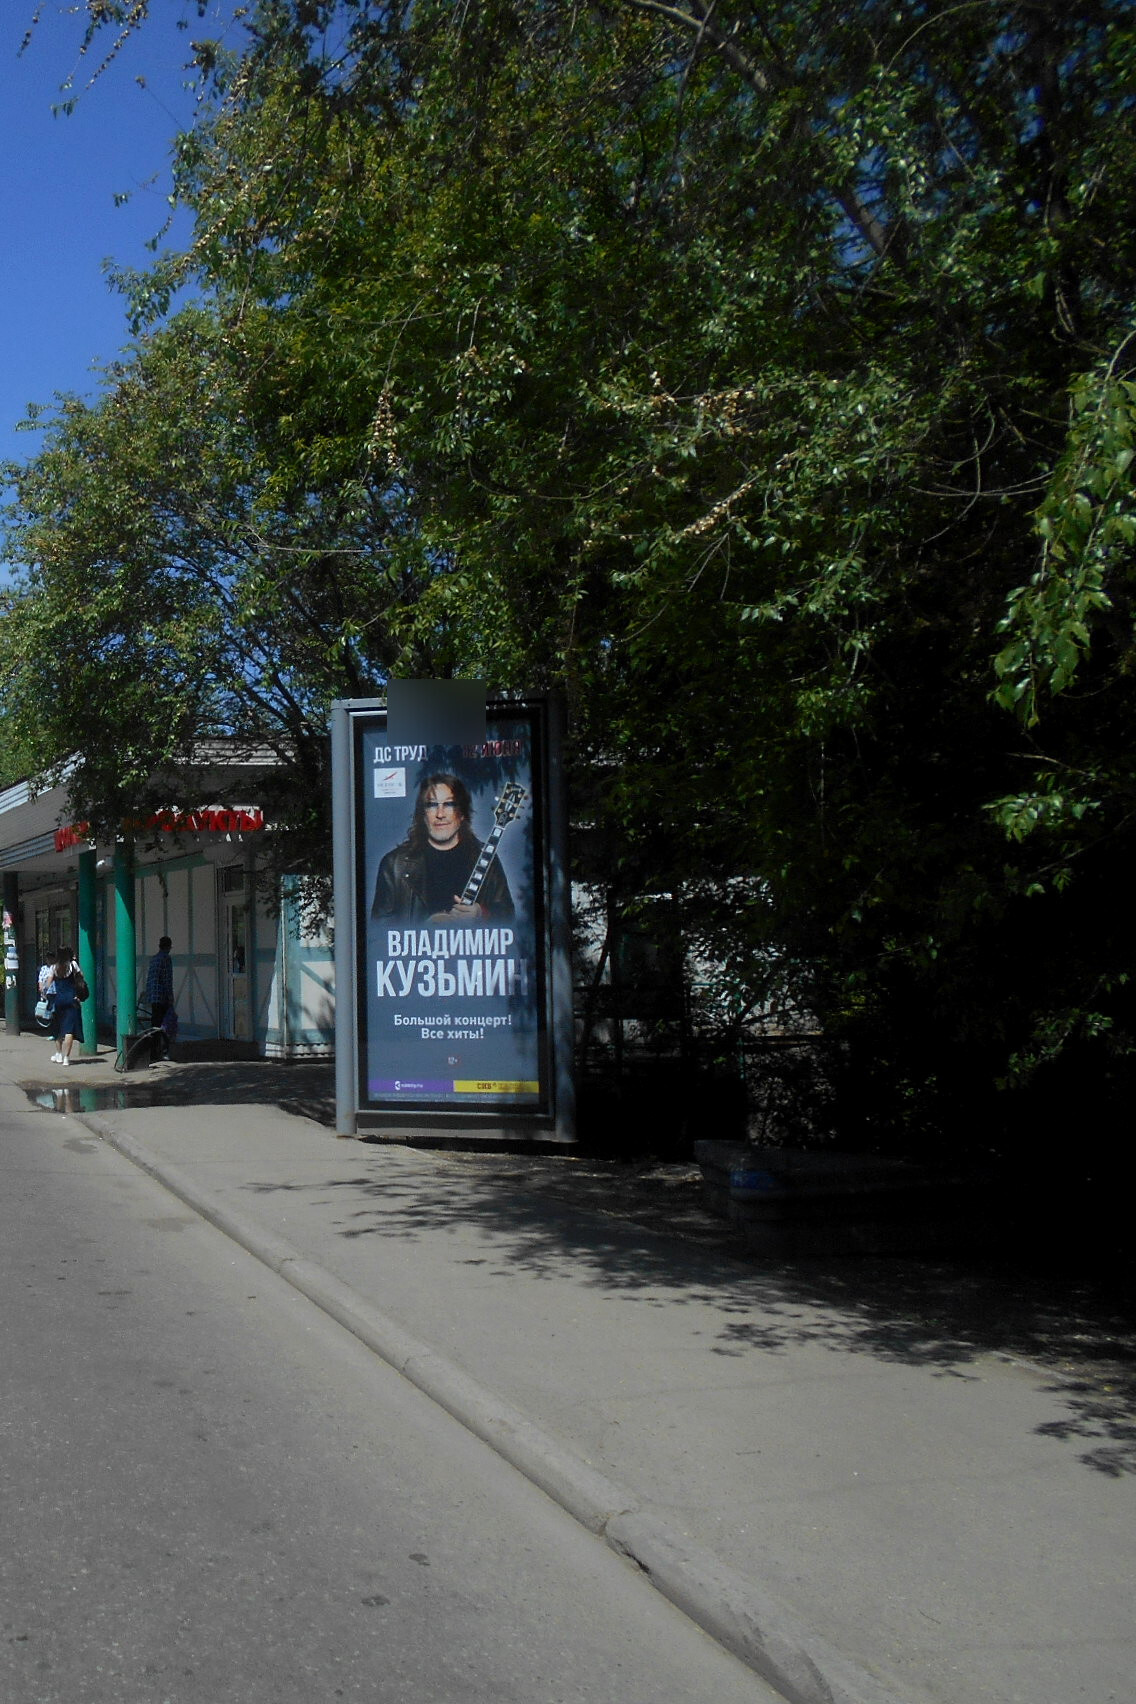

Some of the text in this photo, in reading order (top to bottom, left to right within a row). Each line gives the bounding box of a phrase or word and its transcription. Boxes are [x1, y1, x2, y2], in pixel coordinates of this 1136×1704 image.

[373, 744, 428, 764] ДС ТРУД
[387, 928, 514, 959] ВЛАДИМИР
[376, 958, 529, 998] КУЗЬМИН
[394, 1014, 512, 1029] Большой концерт!
[421, 1028, 485, 1040] Все хиты!
